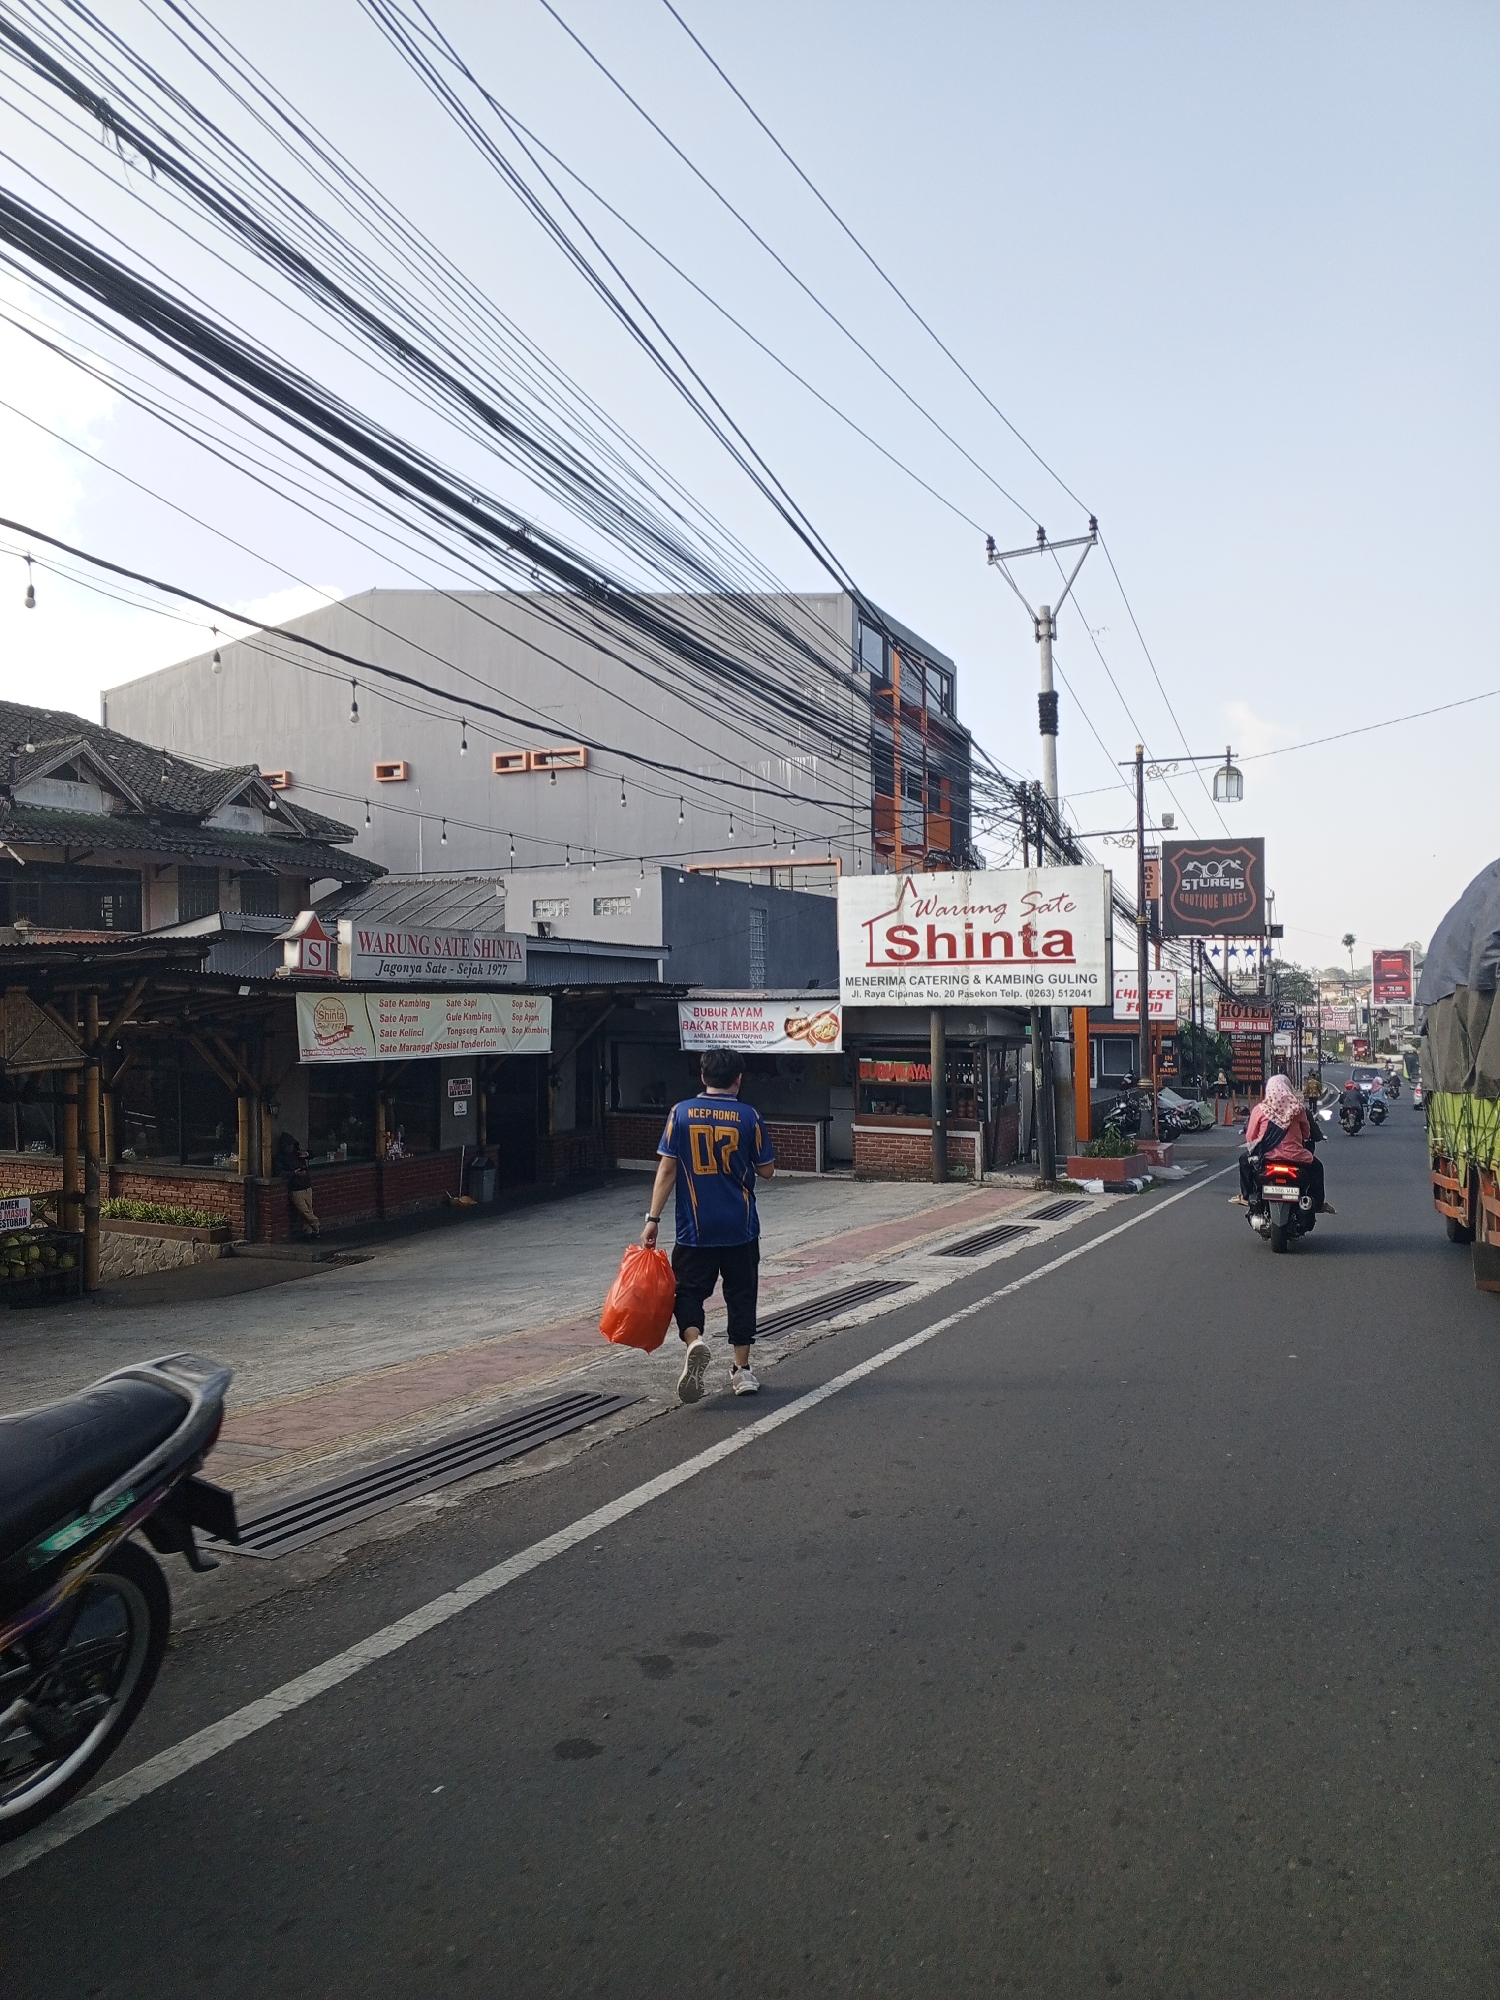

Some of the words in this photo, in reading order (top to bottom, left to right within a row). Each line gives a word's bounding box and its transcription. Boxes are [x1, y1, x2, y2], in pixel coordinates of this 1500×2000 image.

[1182, 878, 1245, 891] STURGIS
[1180, 893, 1218, 910] BOUTIQUE
[1222, 892, 1247, 908] HOTEL
[910, 895, 1007, 924] Warung
[1020, 891, 1077, 917] Sate
[357, 931, 430, 956] WARUNG
[434, 936, 469, 958] SATE
[473, 938, 523, 960] SHINTA
[884, 922, 1074, 961] Shinta
[308, 942, 322, 966] S
[375, 959, 422, 977] Jagonya
[425, 960, 447, 975] Sate
[456, 963, 483, 978] Sejak
[487, 964, 508, 976] 1977
[845, 976, 906, 987] MENERIMA
[909, 975, 969, 986] CATERING
[973, 975, 982, 985] &
[985, 974, 1044, 985] KAMBING
[1048, 973, 1098, 984] GULING
[851, 990, 862, 998] Jl.
[864, 990, 886, 999] Raya
[888, 989, 924, 999] Cipanas
[926, 990, 942, 998] No.
[944, 990, 955, 998] 20
[958, 989, 998, 998] Pasekon
[1000, 989, 1023, 998] Telp.
[1025, 989, 1055, 999] (0263)
[1058, 989, 1092, 998] 512041
[1115, 989, 1175, 1000] CHIESE
[379, 999, 397, 1008] Sate
[399, 999, 430, 1010] Kambing
[446, 998, 461, 1007] Sate
[463, 998, 478, 1008] Sapi
[511, 1000, 523, 1009] Sop
[524, 1000, 537, 1009] Sapi
[318, 1010, 344, 1021] Shinta
[693, 1007, 728, 1017] BUBUR
[731, 1007, 763, 1018] AYAM
[1220, 1003, 1269, 1018] HOTEL
[379, 1014, 397, 1023] Sate
[398, 1014, 418, 1024] Ayam
[446, 1013, 461, 1021] Gule
[463, 1012, 492, 1022] Kambing
[511, 1013, 523, 1022] Sop
[524, 1013, 540, 1022] Ayam
[447, 1027, 477, 1036] Tongseng
[480, 1026, 506, 1035] Kambing
[511, 1027, 523, 1035] Sop
[524, 1026, 549, 1036] Kambing
[682, 1021, 719, 1031] BAKAR
[721, 1021, 775, 1032] TEMBIKAR
[379, 1029, 397, 1038] Sate
[399, 1028, 424, 1037] Kelinci
[380, 1044, 397, 1053] Sate
[400, 1042, 433, 1052] Maranggi
[434, 1041, 459, 1051] Spesial
[461, 1039, 497, 1049] Tenderloin
[689, 1124, 739, 1175] 07
[4, 1208, 28, 1218] MASUK
